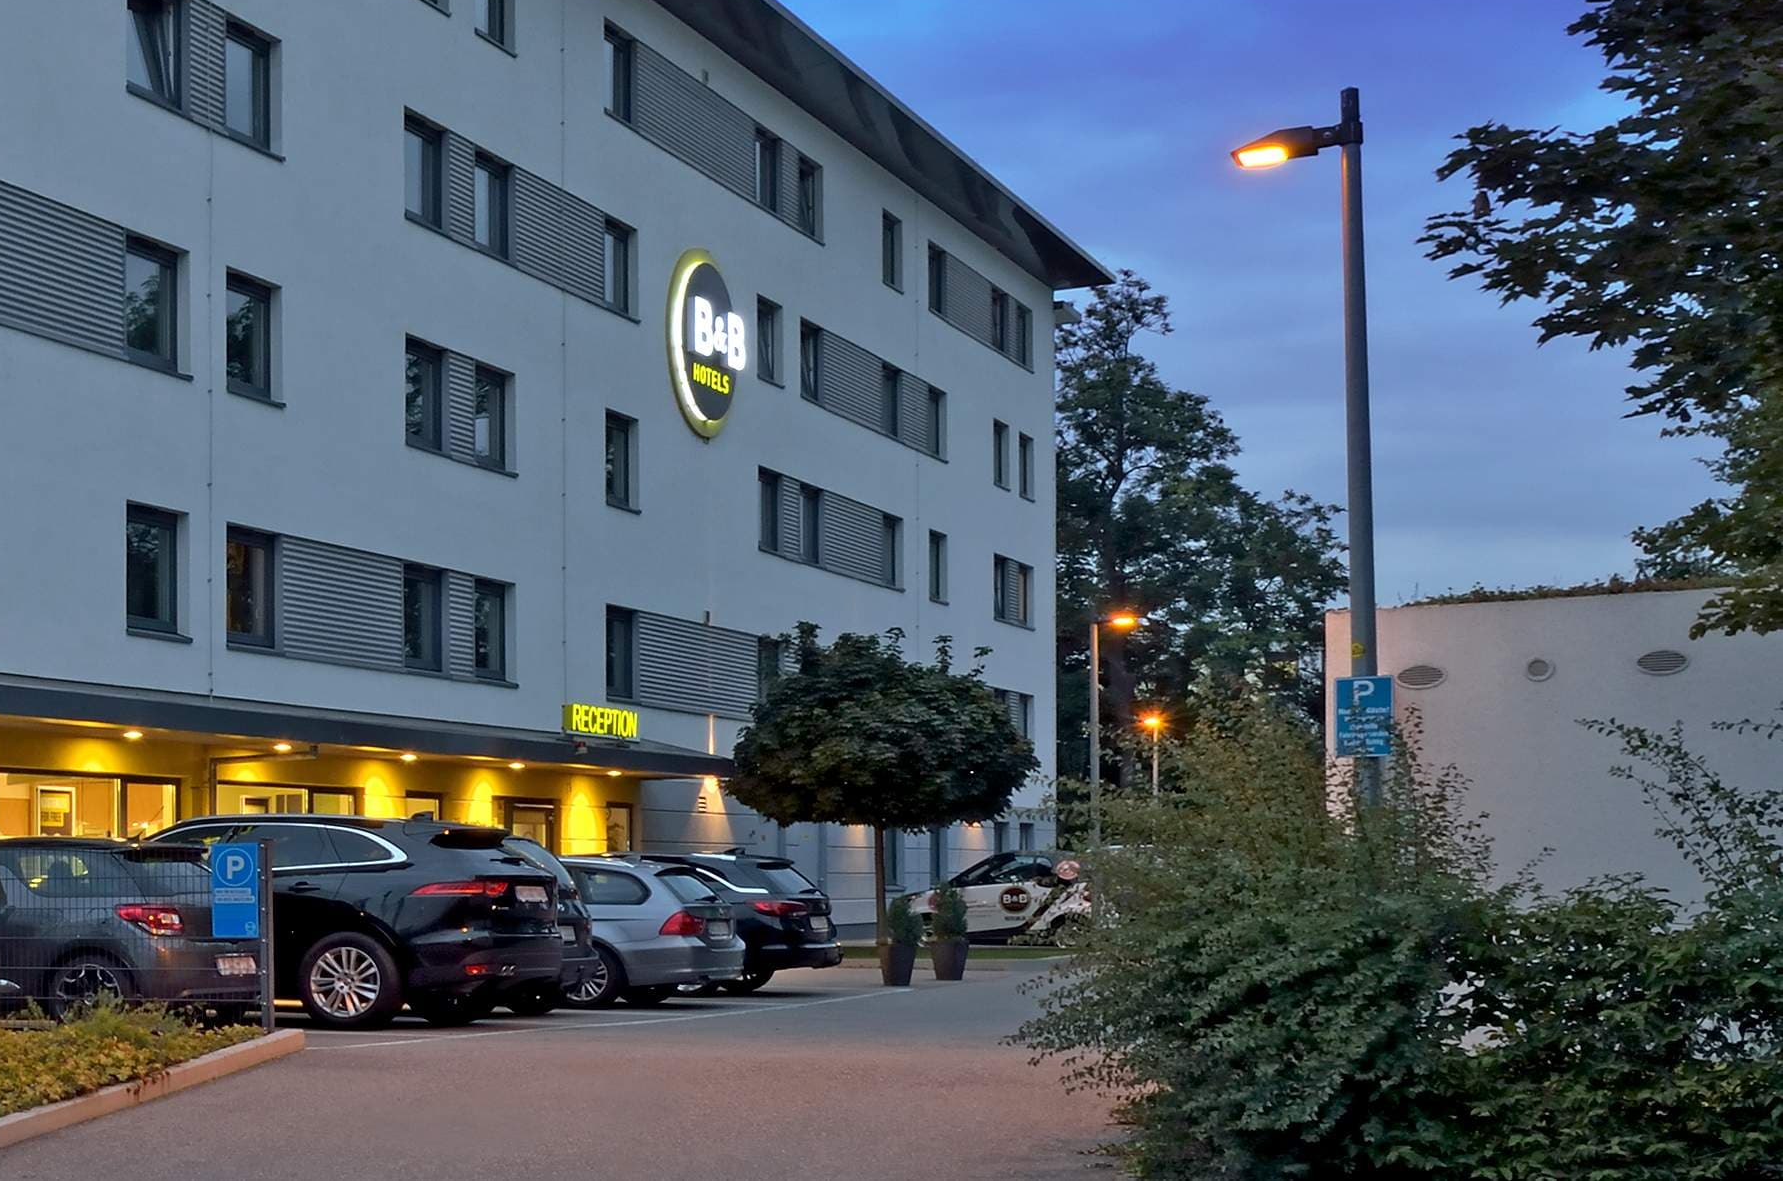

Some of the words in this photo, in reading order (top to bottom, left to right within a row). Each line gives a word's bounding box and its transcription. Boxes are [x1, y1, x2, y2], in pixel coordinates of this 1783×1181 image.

[693, 295, 747, 371] B&B
[692, 362, 730, 395] HOTELS
[1353, 680, 1375, 705] P
[572, 703, 638, 738] RECEPTION
[226, 855, 245, 880] P
[1002, 893, 1029, 904] B&B
